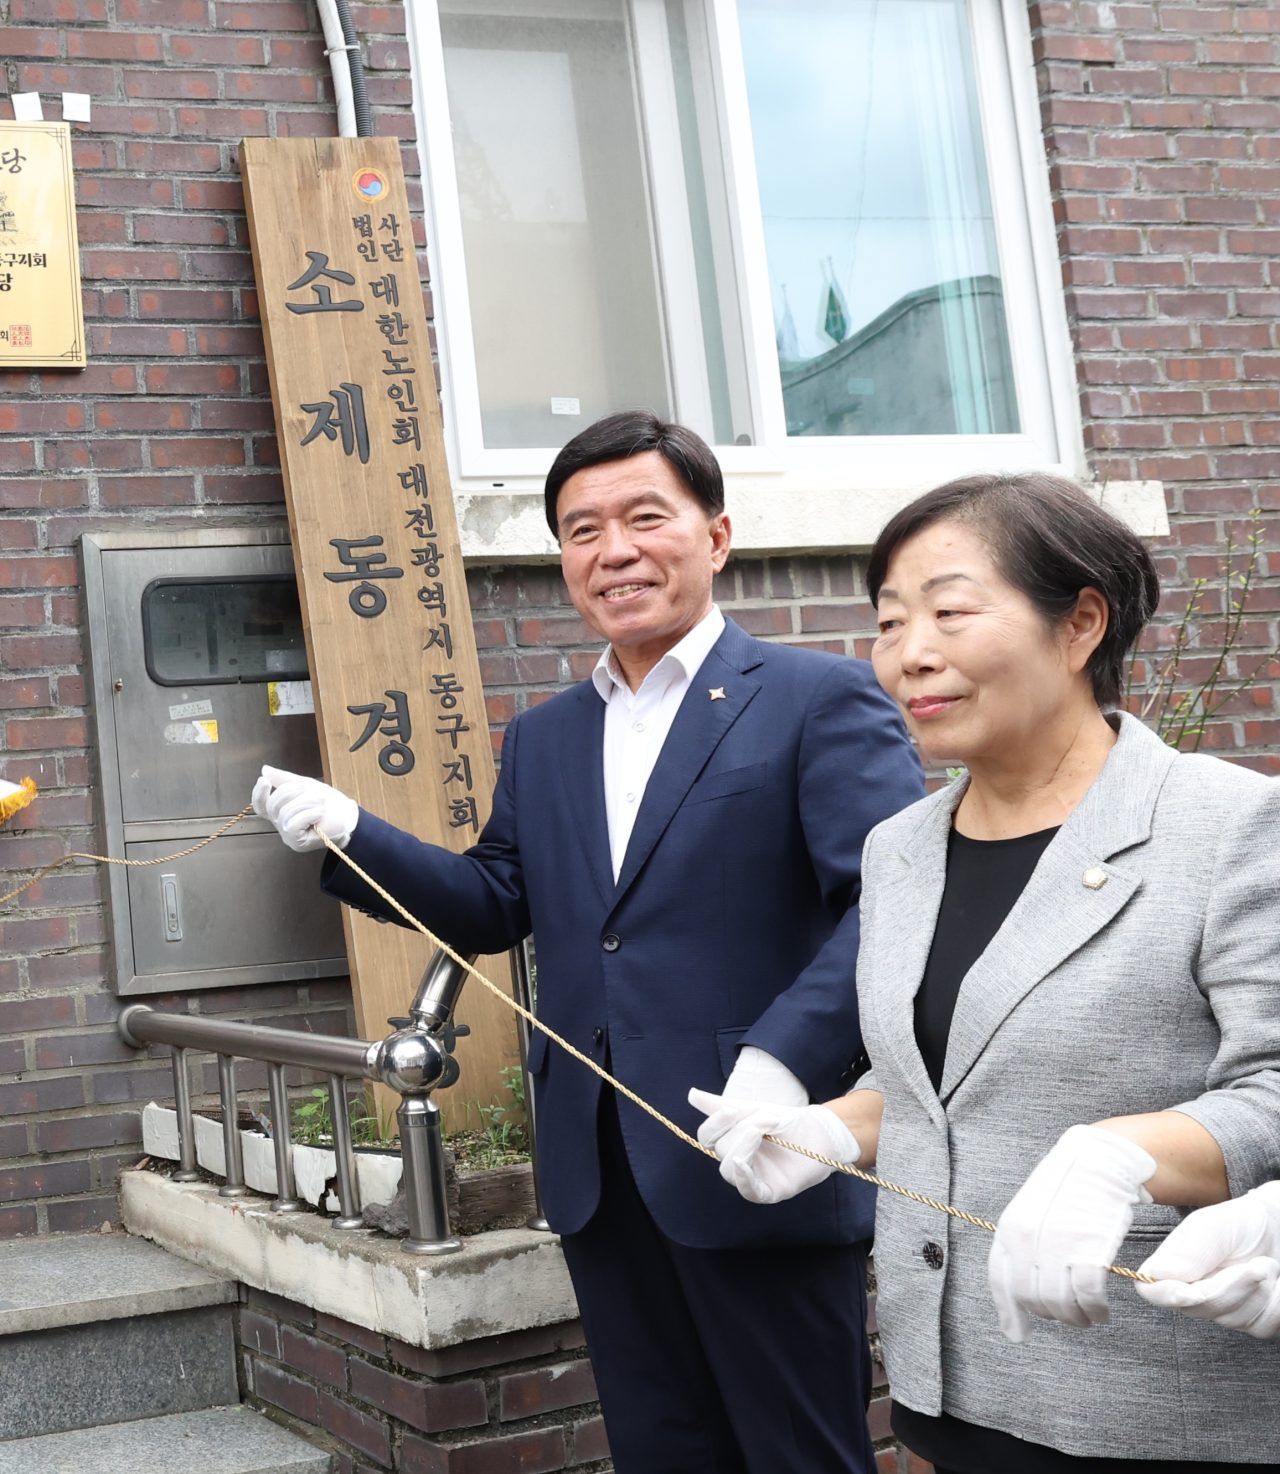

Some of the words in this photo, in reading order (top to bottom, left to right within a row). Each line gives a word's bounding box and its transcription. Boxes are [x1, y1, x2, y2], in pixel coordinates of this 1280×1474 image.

[369, 273, 421, 452] 대한노인회
[397, 463, 453, 660] 대전광역시
[429, 672, 479, 834] 동구지회
